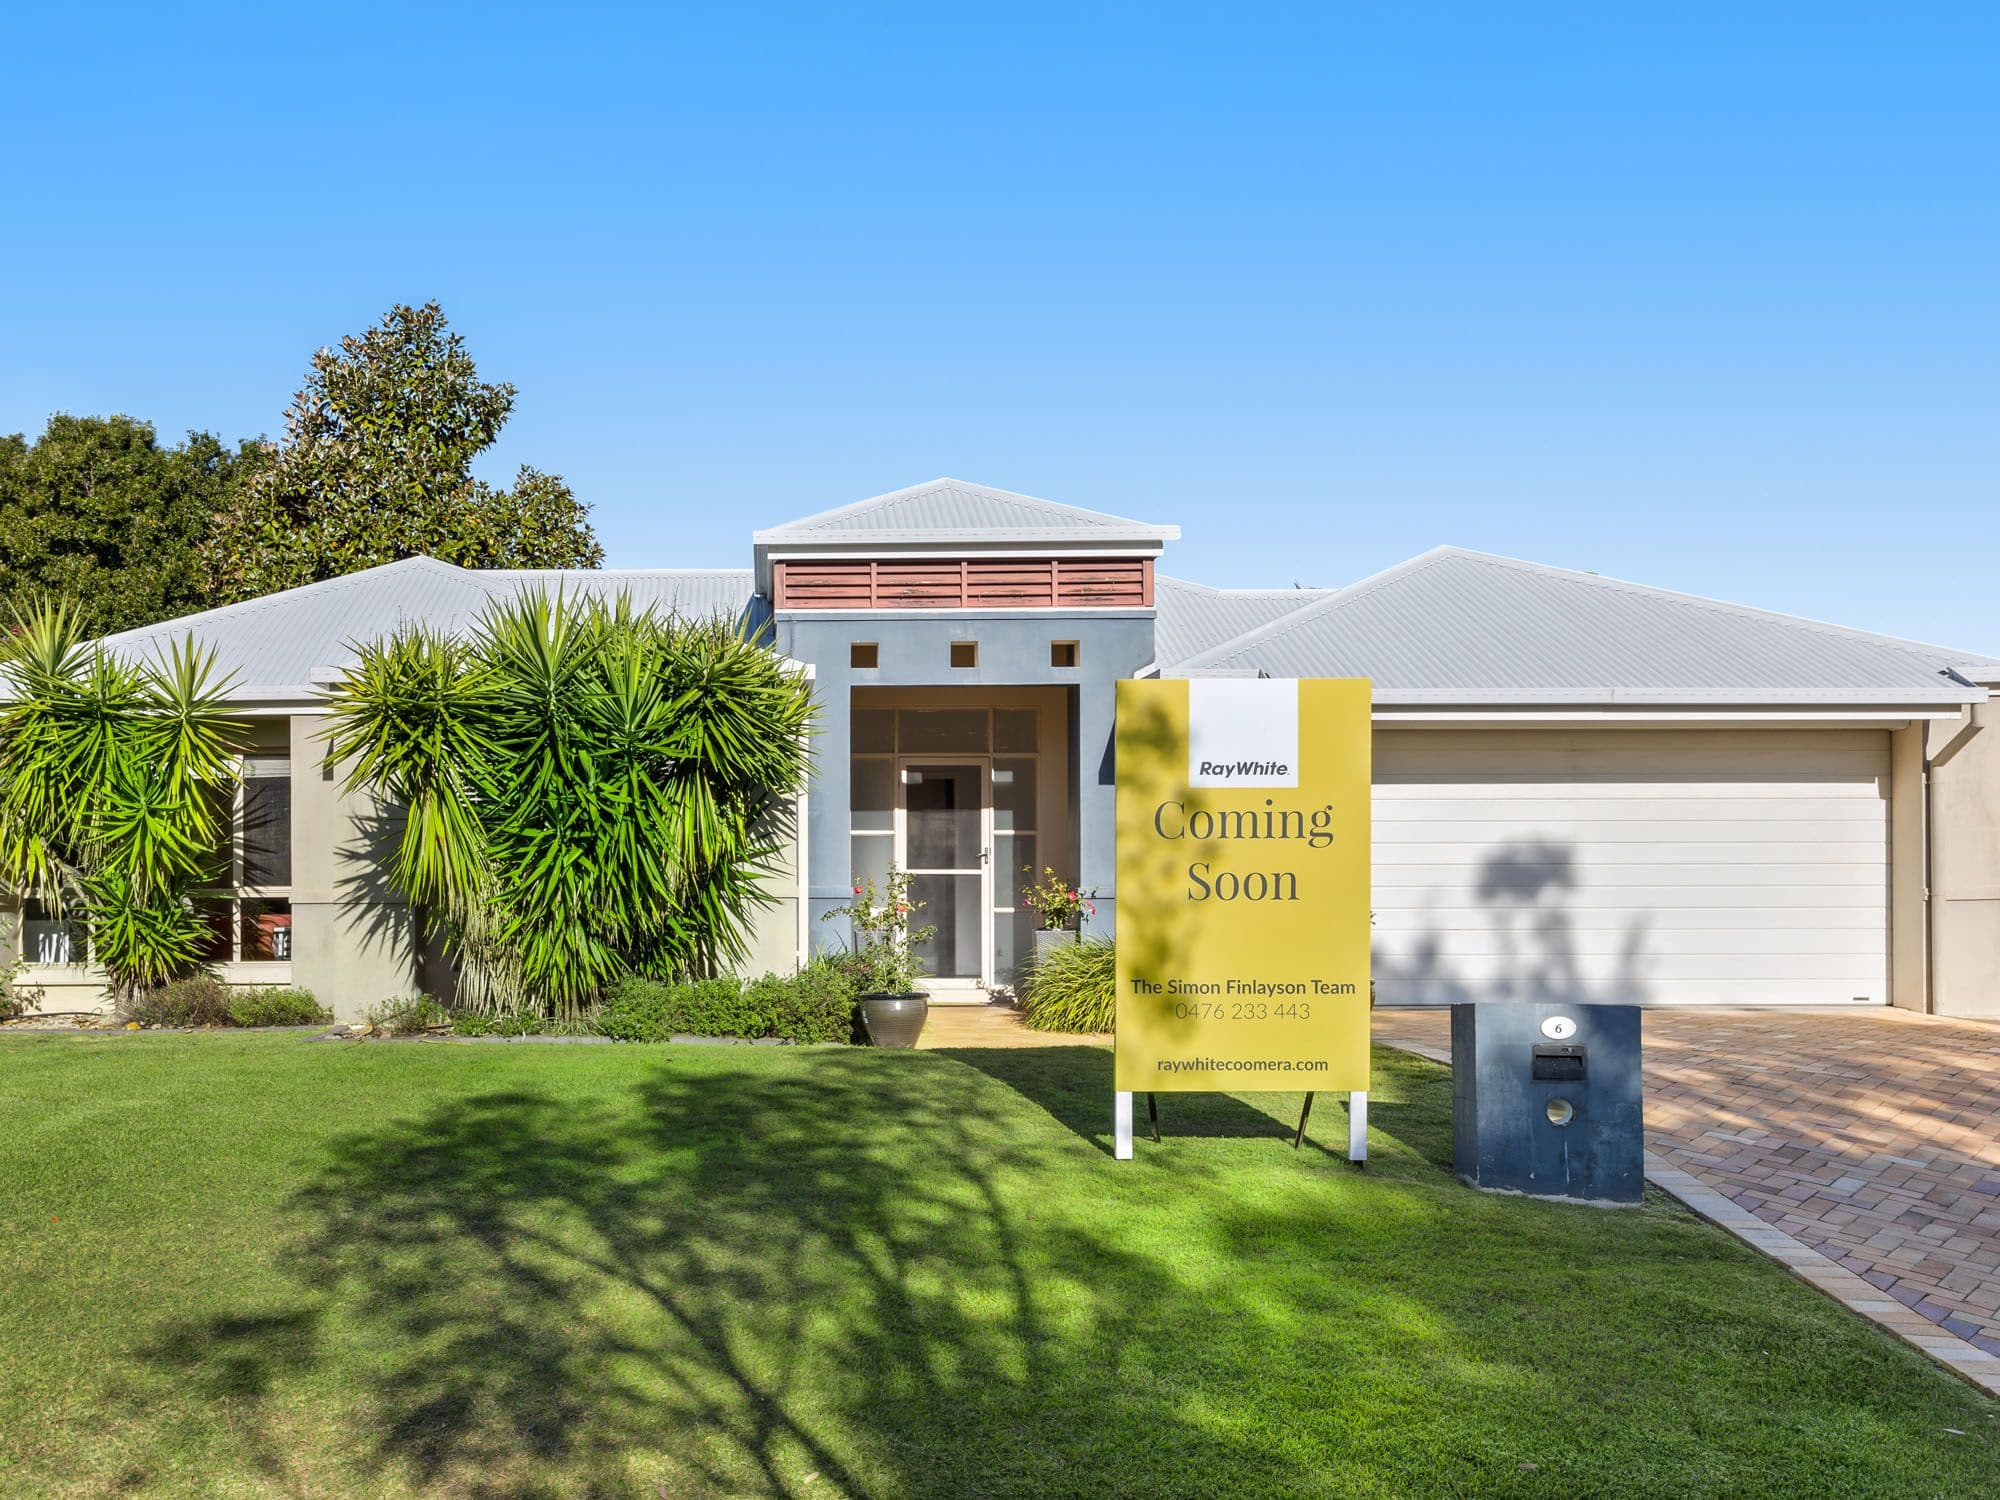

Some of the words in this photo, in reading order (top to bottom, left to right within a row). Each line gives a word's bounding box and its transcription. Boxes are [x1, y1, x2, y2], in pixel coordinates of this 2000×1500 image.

[1154, 799, 1334, 848] Coming
[1188, 862, 1300, 901] Soon
[1131, 980, 1162, 995] The
[1168, 980, 1221, 995] Simon
[1226, 980, 1306, 998] Finlayson
[1311, 980, 1356, 995] Team
[1175, 1003, 1225, 1020] 0476
[1231, 1003, 1268, 1020] 233
[1274, 1003, 1310, 1020] 443
[1555, 1024, 1562, 1034] 6
[1157, 1057, 1329, 1073] raywhitecoomera.com
